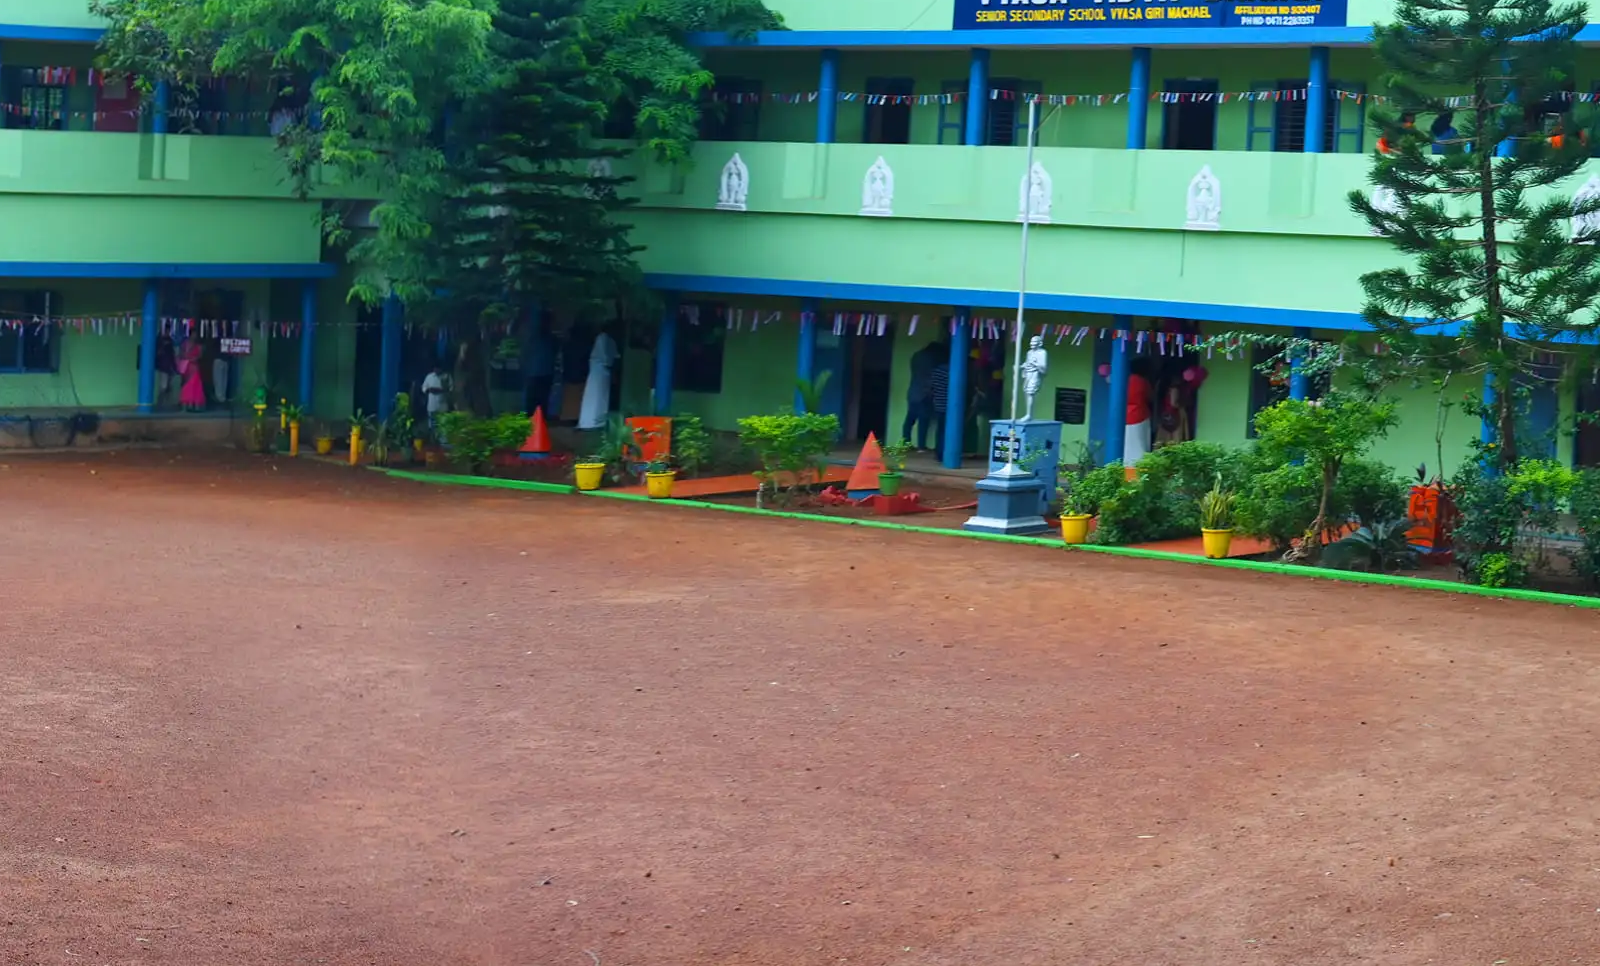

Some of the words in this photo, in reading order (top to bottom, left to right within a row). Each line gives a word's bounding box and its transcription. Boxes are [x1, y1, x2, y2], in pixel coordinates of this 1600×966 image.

[976, 10, 1007, 22] SENIOR
[1009, 9, 1065, 22] SECONDARY
[1068, 8, 1107, 21] SCHOOL
[1110, 7, 1143, 20] VYASA
[1145, 7, 1164, 19] GIRI
[1167, 6, 1211, 19] MACHAEL
